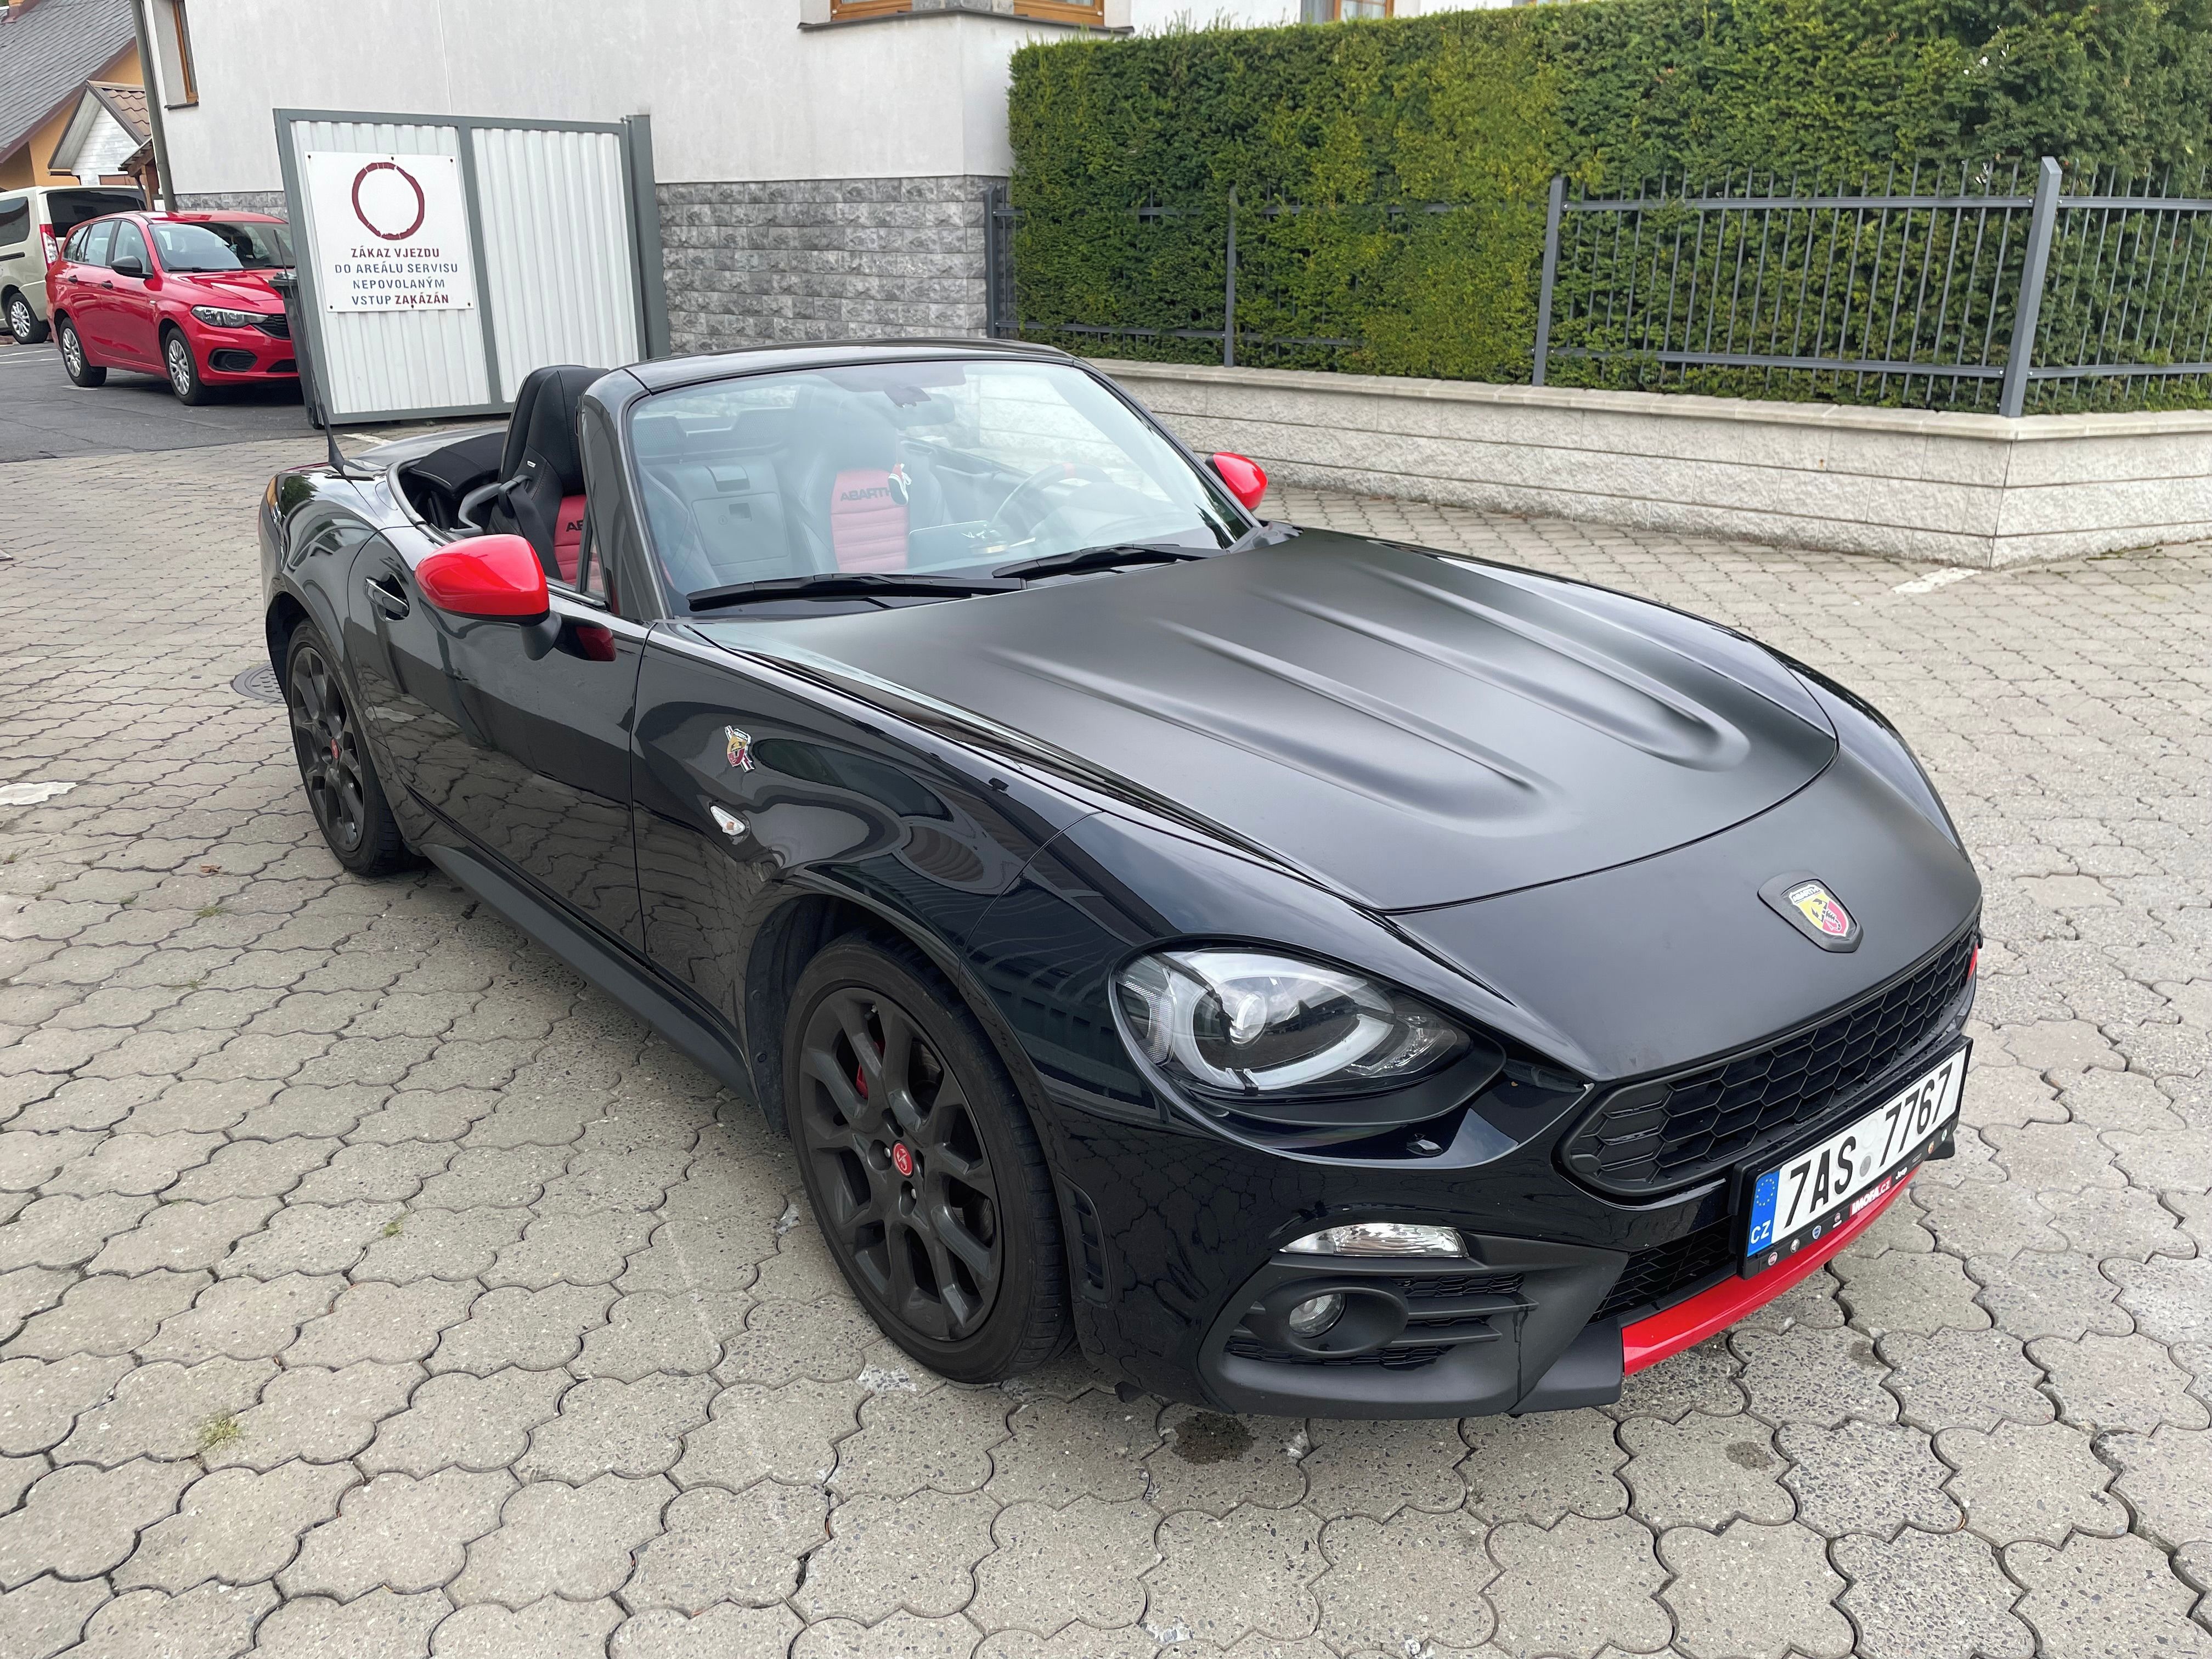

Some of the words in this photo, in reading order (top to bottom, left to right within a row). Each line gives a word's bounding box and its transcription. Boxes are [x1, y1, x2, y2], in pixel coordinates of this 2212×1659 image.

[351, 246, 391, 258] ZÁKAZ
[394, 248, 439, 258] VJEZDU
[335, 264, 351, 273] DO
[357, 261, 403, 273] AREÁLU
[407, 263, 458, 273] SERVISU
[353, 276, 445, 289] NEPOVOLANÝM
[352, 295, 391, 305] VSTUP
[394, 292, 449, 304] ZAKÁZÁN
[1784, 1136, 1857, 1229] 7AS
[1878, 1062, 1953, 1169] 7767
[1750, 1220, 1771, 1244] CZ
